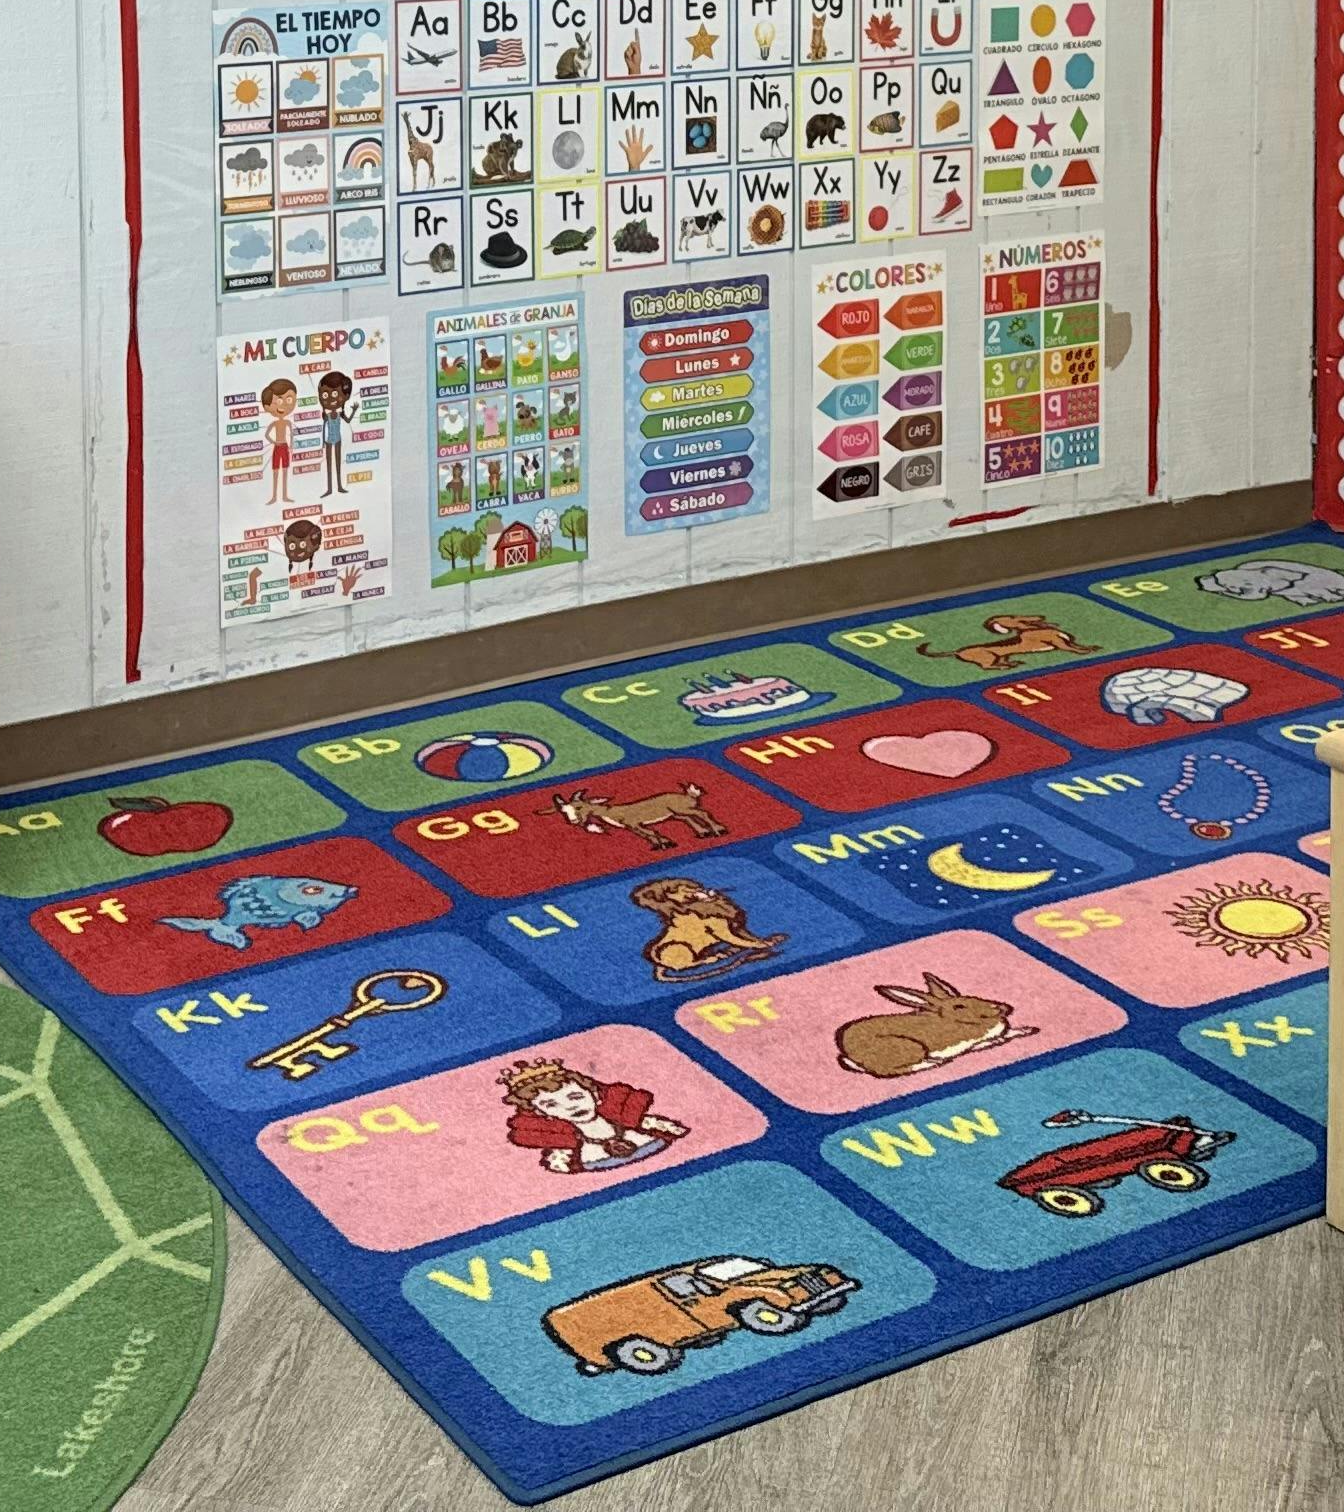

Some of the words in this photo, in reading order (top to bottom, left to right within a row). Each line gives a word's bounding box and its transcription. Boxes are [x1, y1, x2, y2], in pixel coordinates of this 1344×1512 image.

[276, 12, 298, 33] EL
[302, 8, 381, 32] TIEMPO
[410, 5, 449, 37] Aa
[483, 0, 518, 32] Bb
[307, 33, 353, 55] HOY
[750, 73, 782, 110] Ññ
[811, 76, 843, 105] Oo
[873, 71, 901, 106] Pp
[931, 67, 962, 96] Qu
[558, 94, 581, 125] Ll
[611, 90, 660, 121] Mm
[685, 85, 718, 115] Nn
[415, 104, 444, 144] Jj
[484, 99, 519, 131] Kk
[813, 166, 842, 196] Xx
[874, 160, 902, 195] Yy
[932, 155, 961, 184] Zz
[620, 184, 653, 215] Uu
[687, 178, 718, 208] Vv
[742, 172, 790, 203] Ww
[486, 198, 519, 229] Ss
[555, 190, 585, 221] Tt
[414, 206, 448, 238] Rr
[999, 239, 1087, 269] NÚMEROS
[836, 262, 926, 293] COLORES
[1045, 271, 1059, 293] 6
[632, 295, 663, 319] Días
[667, 293, 684, 311] de
[687, 290, 701, 309] la
[705, 284, 760, 306] Semana
[437, 312, 508, 334] ANIMALES
[509, 311, 521, 324] de
[524, 303, 575, 322] GRANJA
[841, 310, 870, 325] ROJO
[987, 320, 1001, 343] 2
[1051, 312, 1064, 335] 7
[244, 338, 278, 363] MI
[282, 328, 366, 358] CUERPO
[664, 327, 731, 348] Domingo
[906, 344, 935, 358] VERDE
[550, 369, 579, 380] GANSO
[675, 357, 720, 374] Lunes
[991, 363, 1004, 385] 3
[1050, 352, 1062, 375] 8
[439, 385, 467, 396] GALLO
[672, 383, 724, 402] Martes
[843, 393, 868, 407] AZUL
[662, 409, 733, 431] Miércoles
[988, 403, 1002, 426] 4
[439, 445, 469, 456] OVEJA
[514, 433, 543, 444] PERRO
[672, 440, 722, 458] Jueves
[842, 433, 870, 447] ROSA
[1045, 436, 1065, 460] 10
[906, 464, 933, 479] GRIS
[988, 447, 1001, 470] 5
[670, 465, 726, 485] Viernes
[841, 474, 870, 488] NEGRO
[476, 498, 507, 509] CABRA
[518, 491, 540, 502] VACA
[670, 491, 726, 512] Sábado
[1109, 575, 1173, 601] Ee
[842, 622, 926, 649] Dd
[1259, 627, 1330, 650] Jj
[582, 681, 660, 704] Cc
[1008, 681, 1053, 708] Ii
[313, 735, 401, 766] Bb
[739, 734, 835, 764] Hh
[1045, 768, 1144, 806] Nn
[416, 807, 520, 842] Gg
[790, 817, 926, 866] Mm
[54, 897, 129, 936] Ff
[506, 904, 580, 940] Ll
[1032, 903, 1124, 943] Ss
[156, 990, 268, 1034] Kk
[695, 995, 782, 1034] Rr
[1200, 1014, 1315, 1058] Xx
[287, 1104, 441, 1153] Qq
[842, 1107, 1002, 1168] Ww
[426, 1248, 552, 1302] Vv
[32, 1326, 157, 1479] Lakeshore
